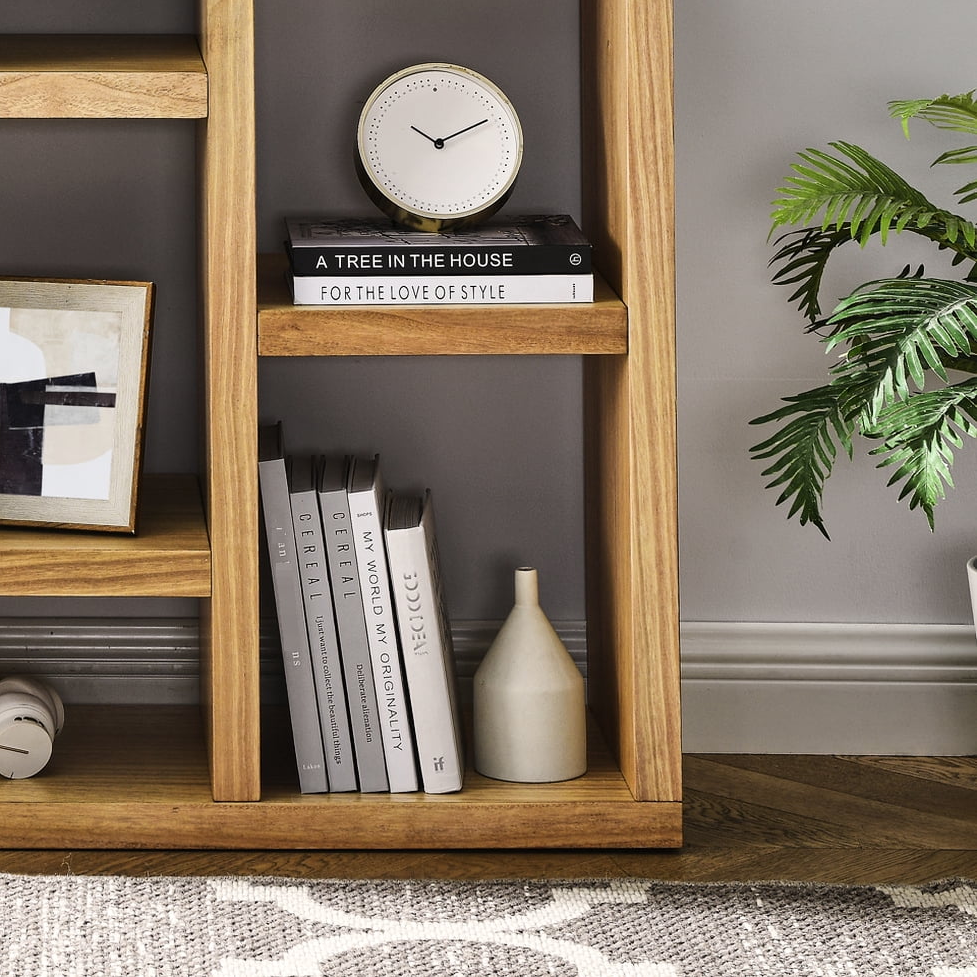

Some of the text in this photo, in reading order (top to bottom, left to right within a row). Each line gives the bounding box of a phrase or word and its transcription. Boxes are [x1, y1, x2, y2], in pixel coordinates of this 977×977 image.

[315, 253, 513, 269] A TREE IN THE HOUSE
[321, 284, 506, 301] FOR THE LOVE OF STYLE
[299, 513, 323, 600] CEREAL
[315, 618, 325, 635] just
[332, 511, 373, 743] CEREAL Deliberate alienation
[319, 635, 328, 656] want
[363, 531, 403, 751] MY WORLD MY ORIGINALITY
[323, 665, 333, 691] collect
[326, 690, 335, 705] the
[328, 704, 340, 741] beautiful
[333, 740, 342, 765] things
